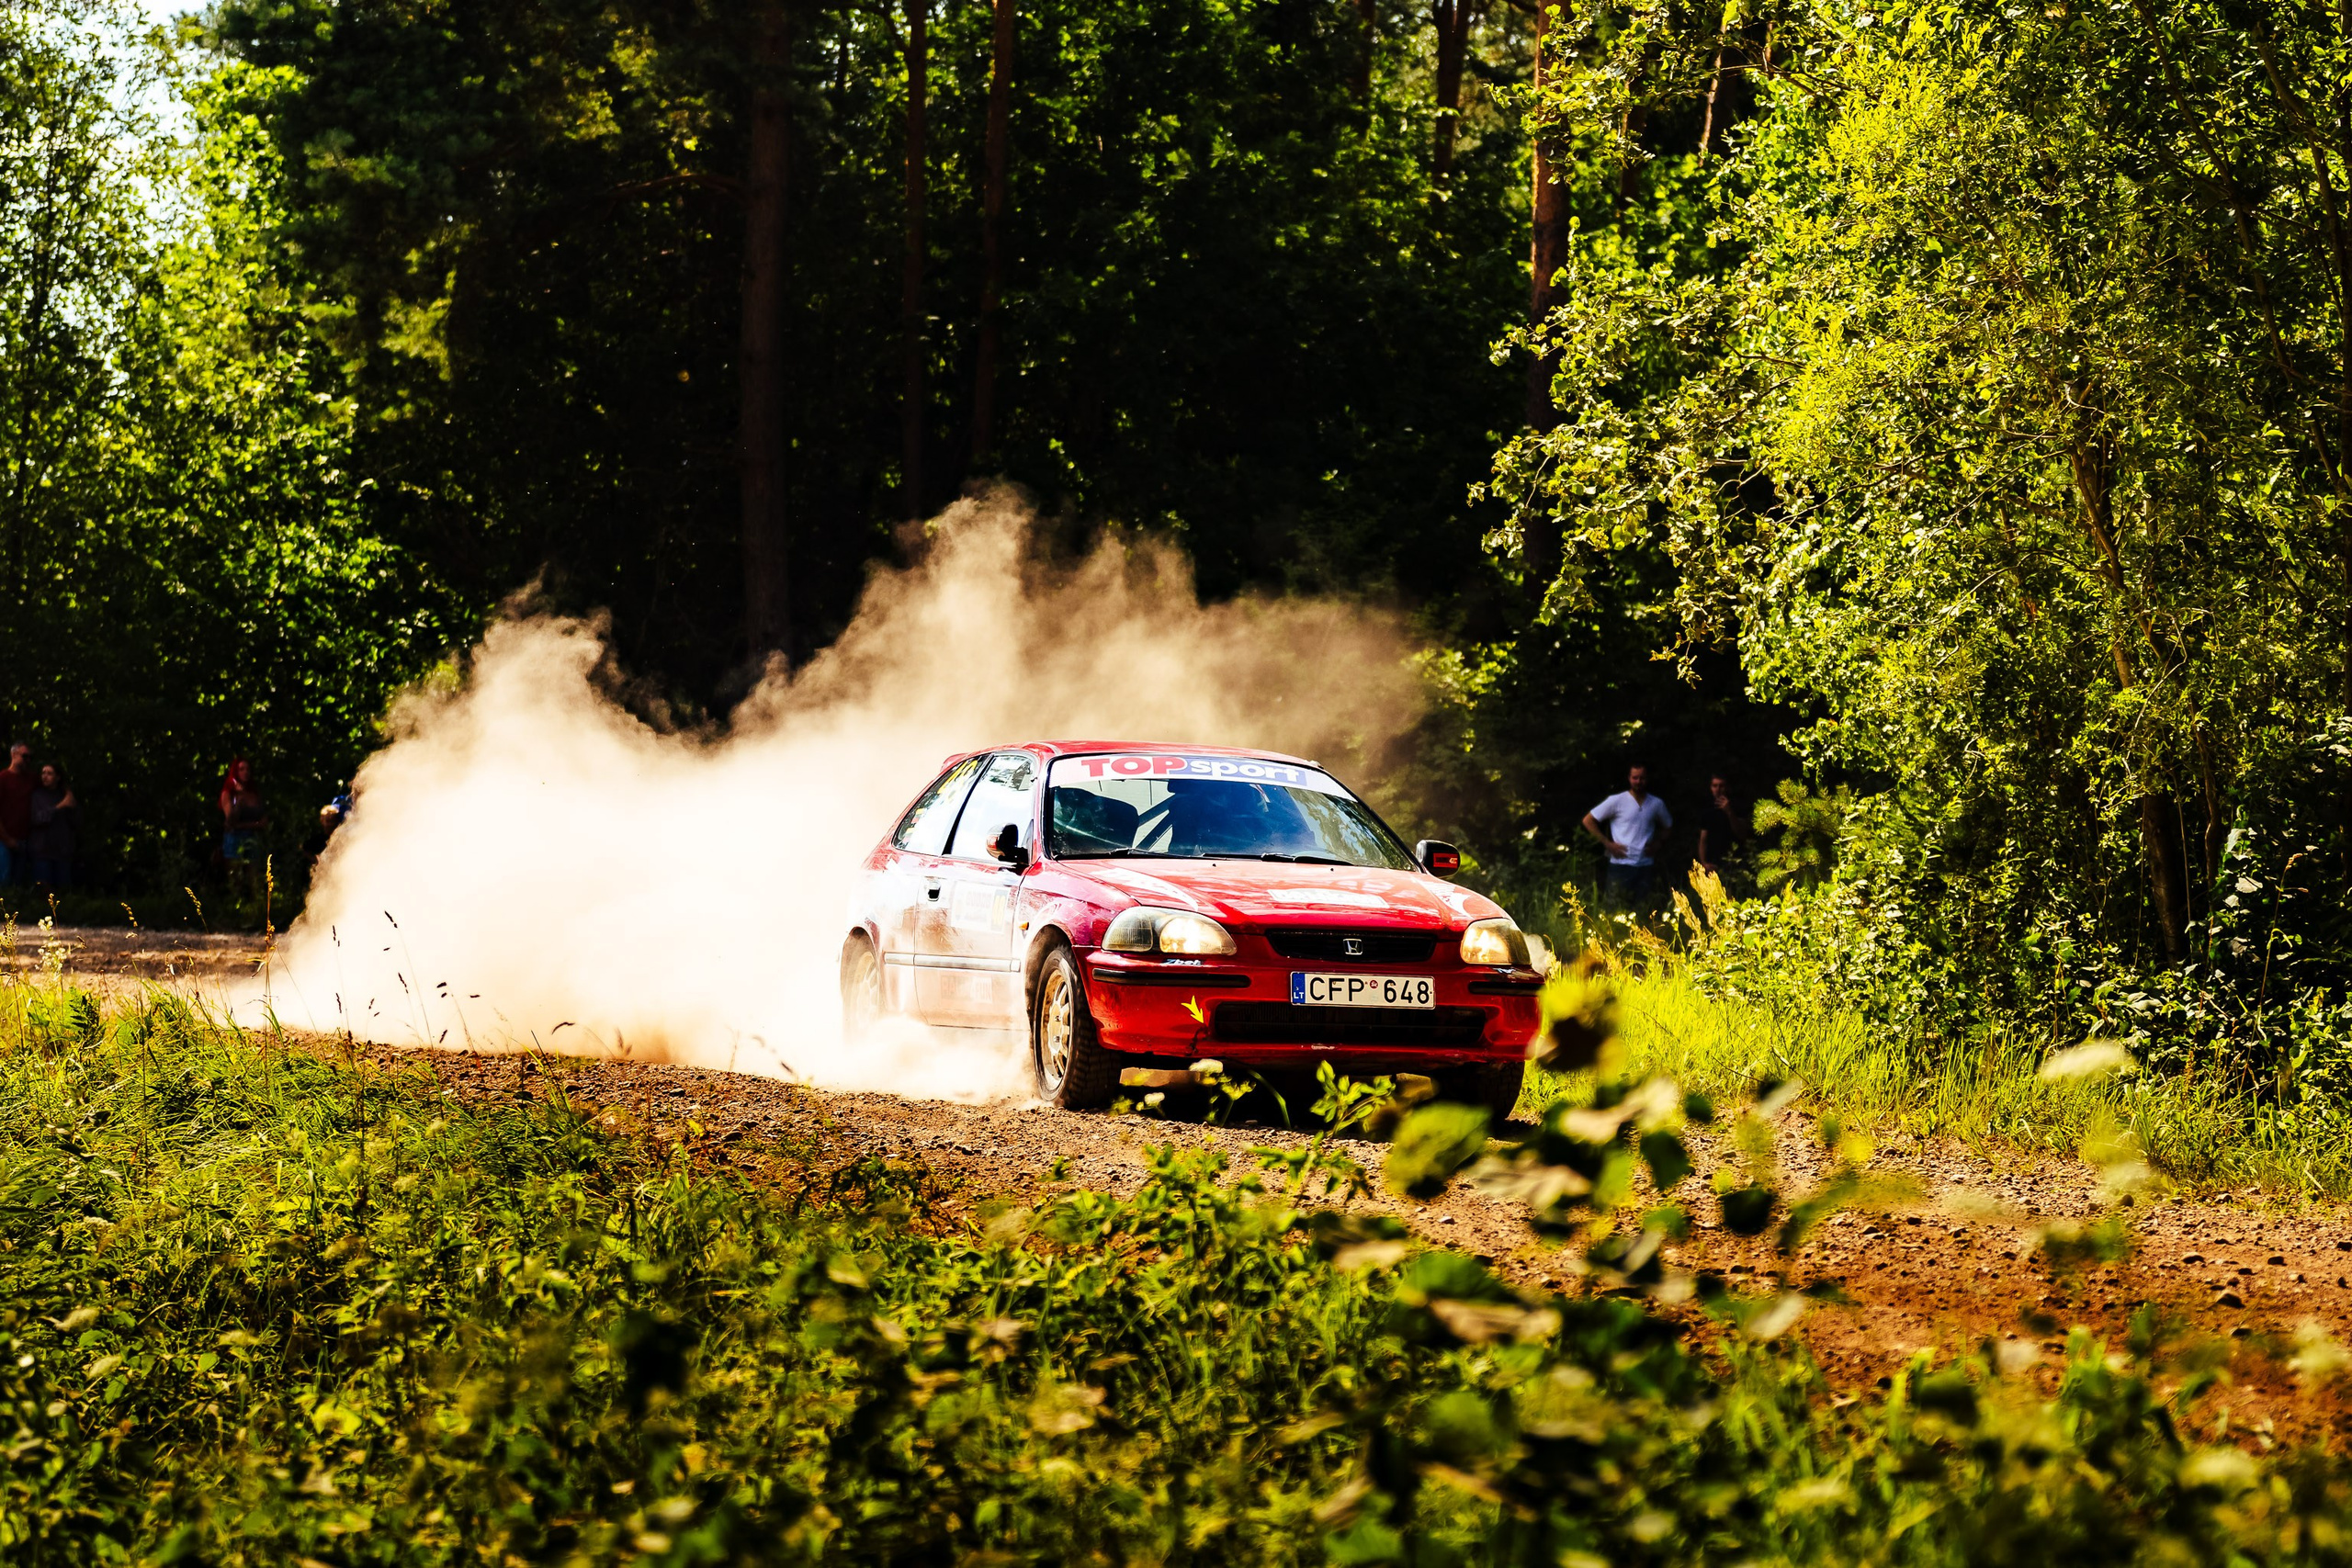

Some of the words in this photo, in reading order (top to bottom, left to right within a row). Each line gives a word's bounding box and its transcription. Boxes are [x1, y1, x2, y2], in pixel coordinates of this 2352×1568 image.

[1081, 756, 1299, 782] TOPsport
[1309, 977, 1365, 1002] CFP
[1384, 979, 1430, 1005] 648
